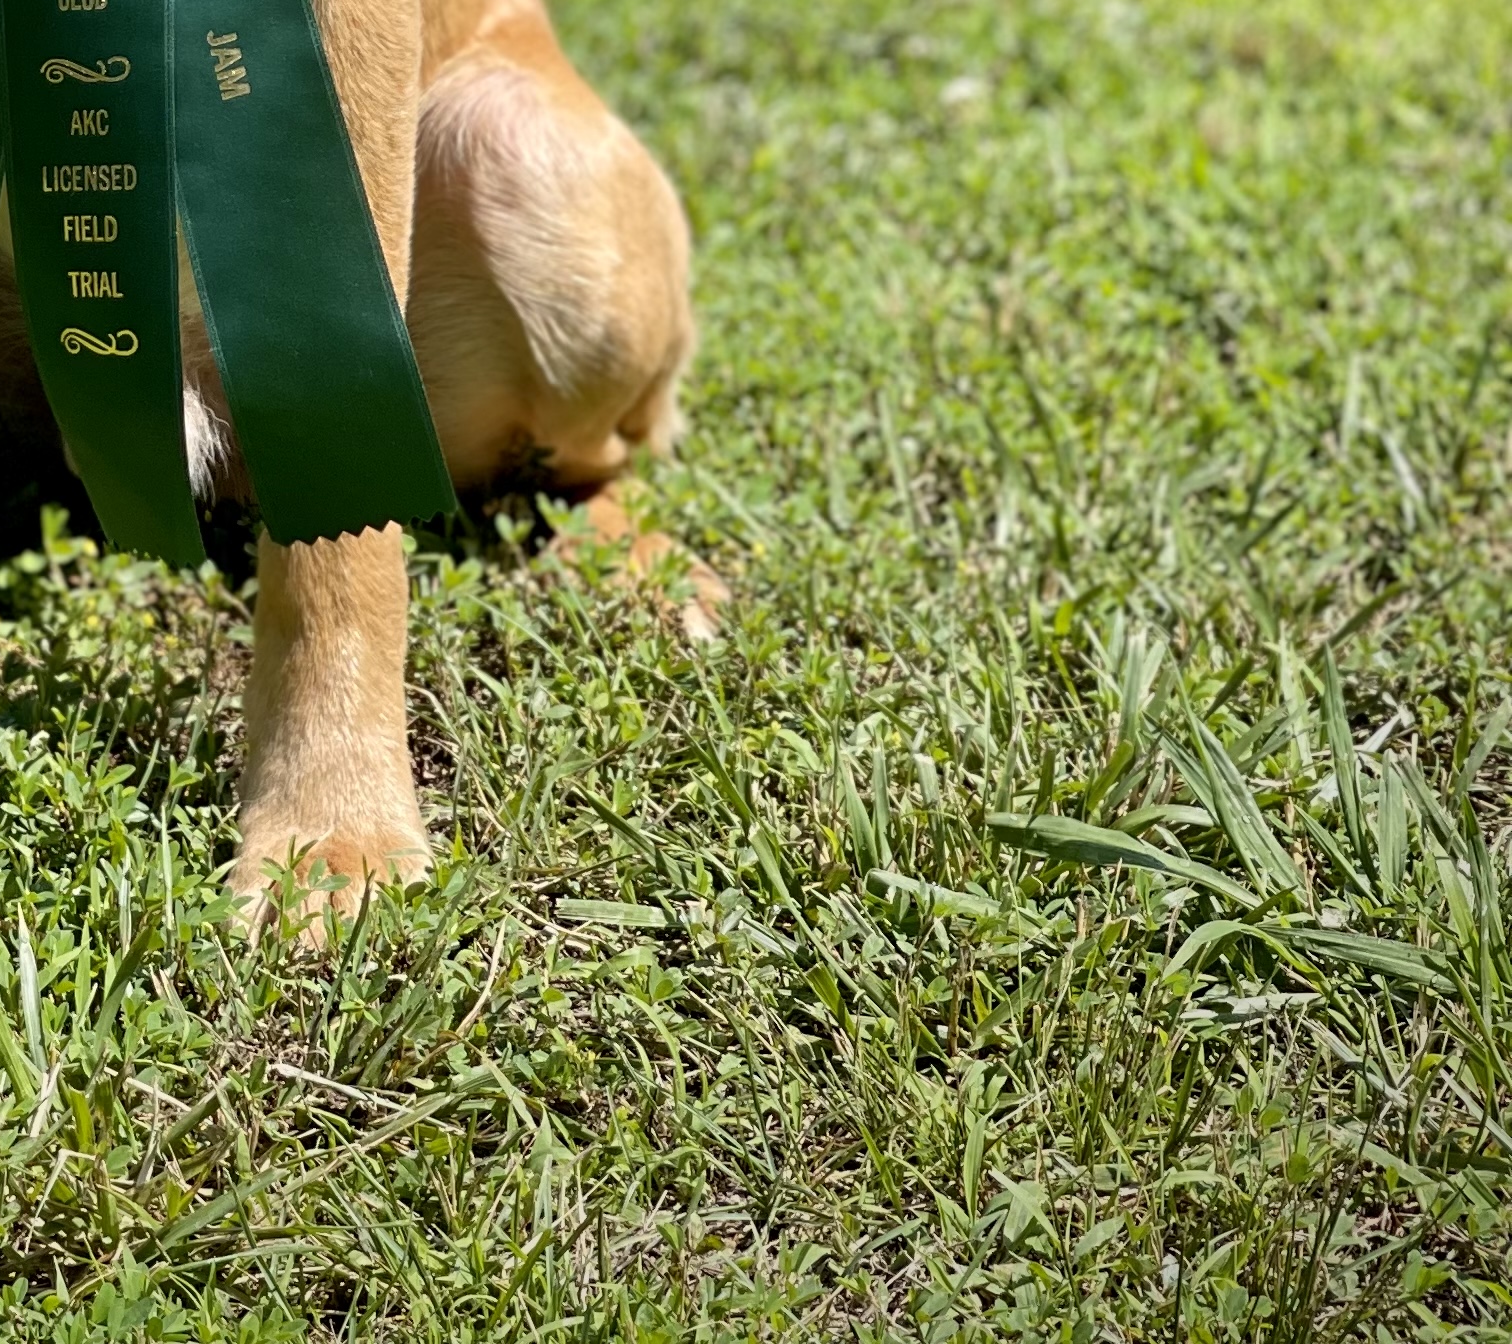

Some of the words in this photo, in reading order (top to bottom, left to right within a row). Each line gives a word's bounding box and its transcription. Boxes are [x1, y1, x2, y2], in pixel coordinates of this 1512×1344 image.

[206, 29, 251, 101] JAM
[70, 109, 110, 136] AKC
[42, 164, 138, 192] LICENSED
[63, 215, 118, 242] FIELD
[68, 271, 124, 298] TRIAL
